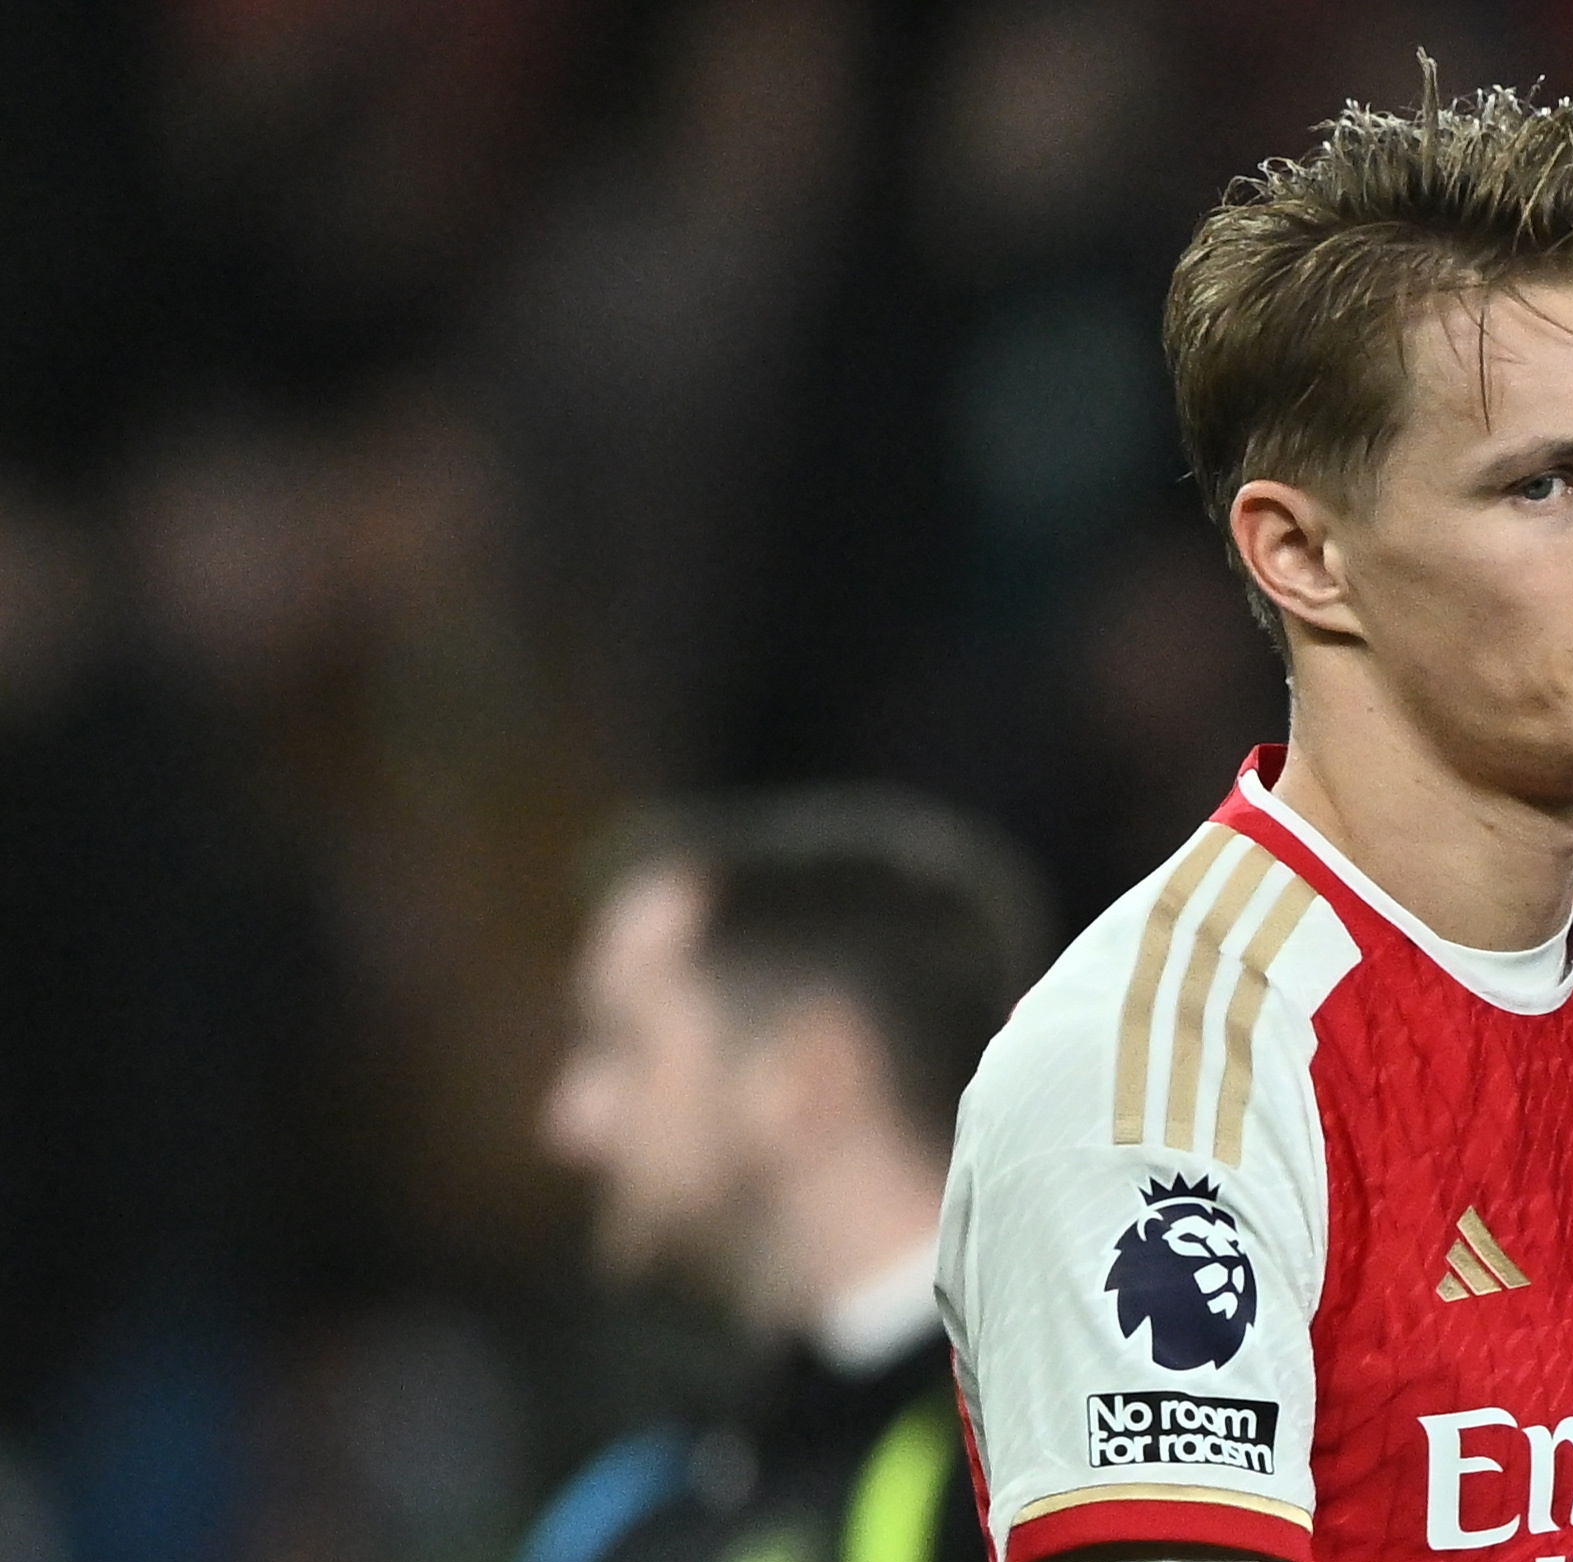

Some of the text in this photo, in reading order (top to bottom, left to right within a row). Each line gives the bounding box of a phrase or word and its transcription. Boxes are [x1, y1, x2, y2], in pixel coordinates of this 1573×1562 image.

[1089, 1395, 1258, 1439] No room
[1090, 1430, 1153, 1467] for
